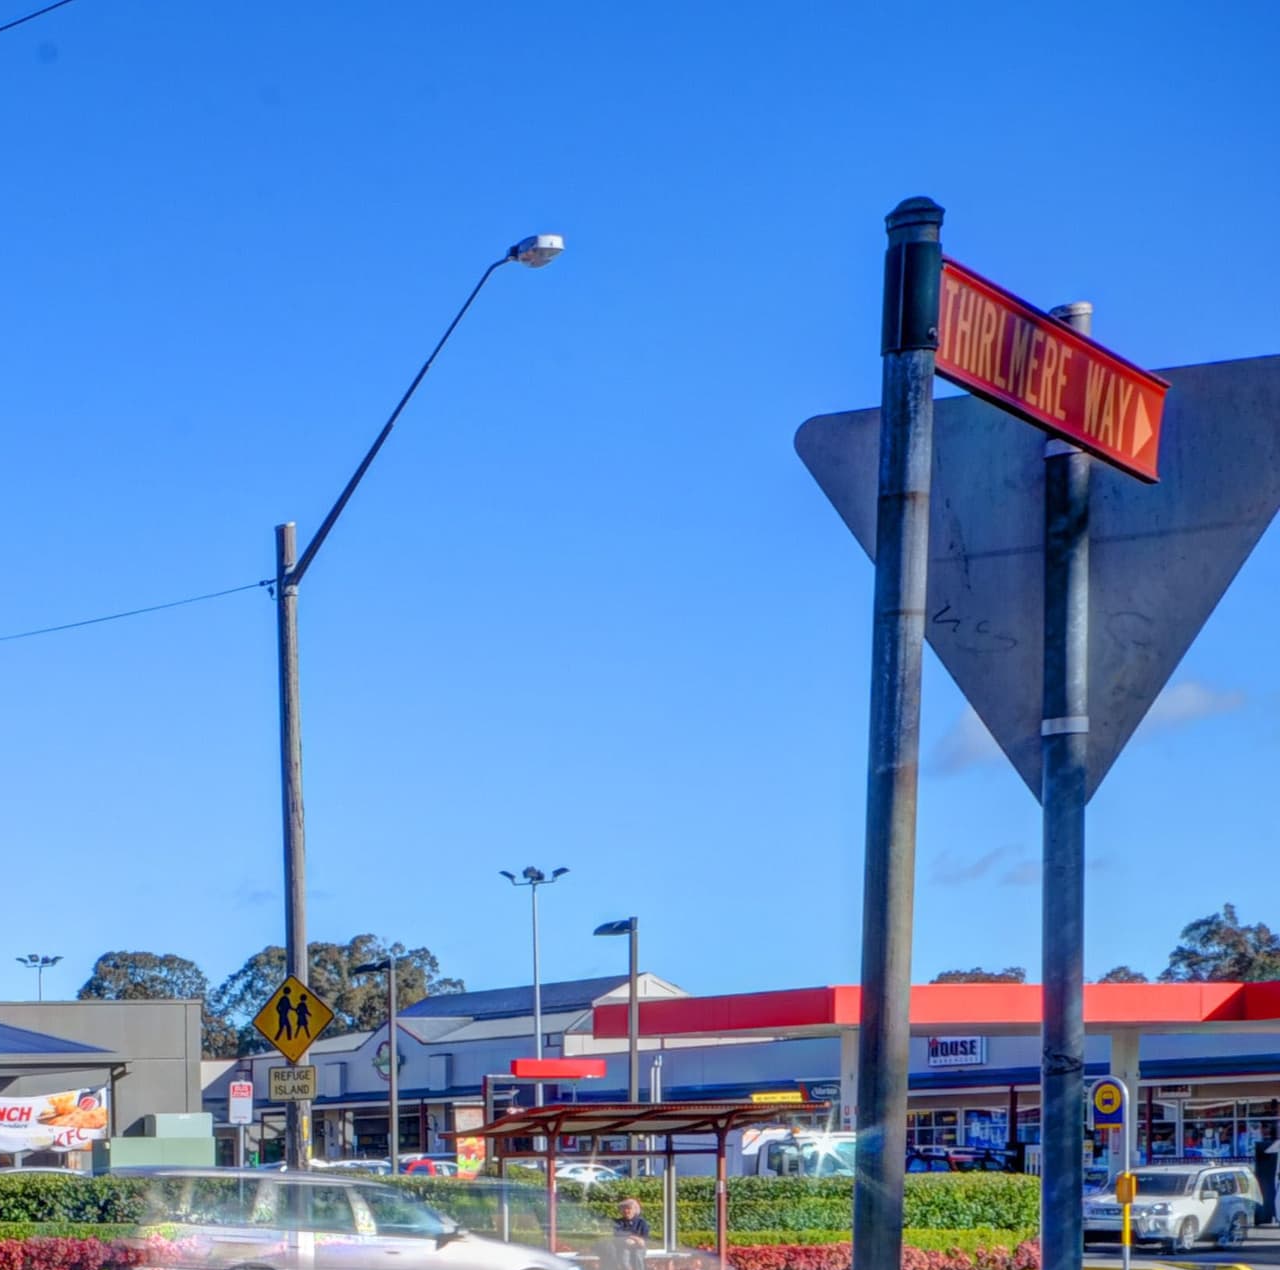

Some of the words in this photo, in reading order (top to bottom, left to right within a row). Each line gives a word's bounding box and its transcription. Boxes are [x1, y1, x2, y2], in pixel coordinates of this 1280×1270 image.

[942, 281, 1071, 421] THIRLMERE
[1083, 359, 1133, 452] WAY
[930, 1039, 976, 1057] HOUSE
[274, 1070, 310, 1080] REFUGE
[275, 1084, 309, 1095] ISLAND
